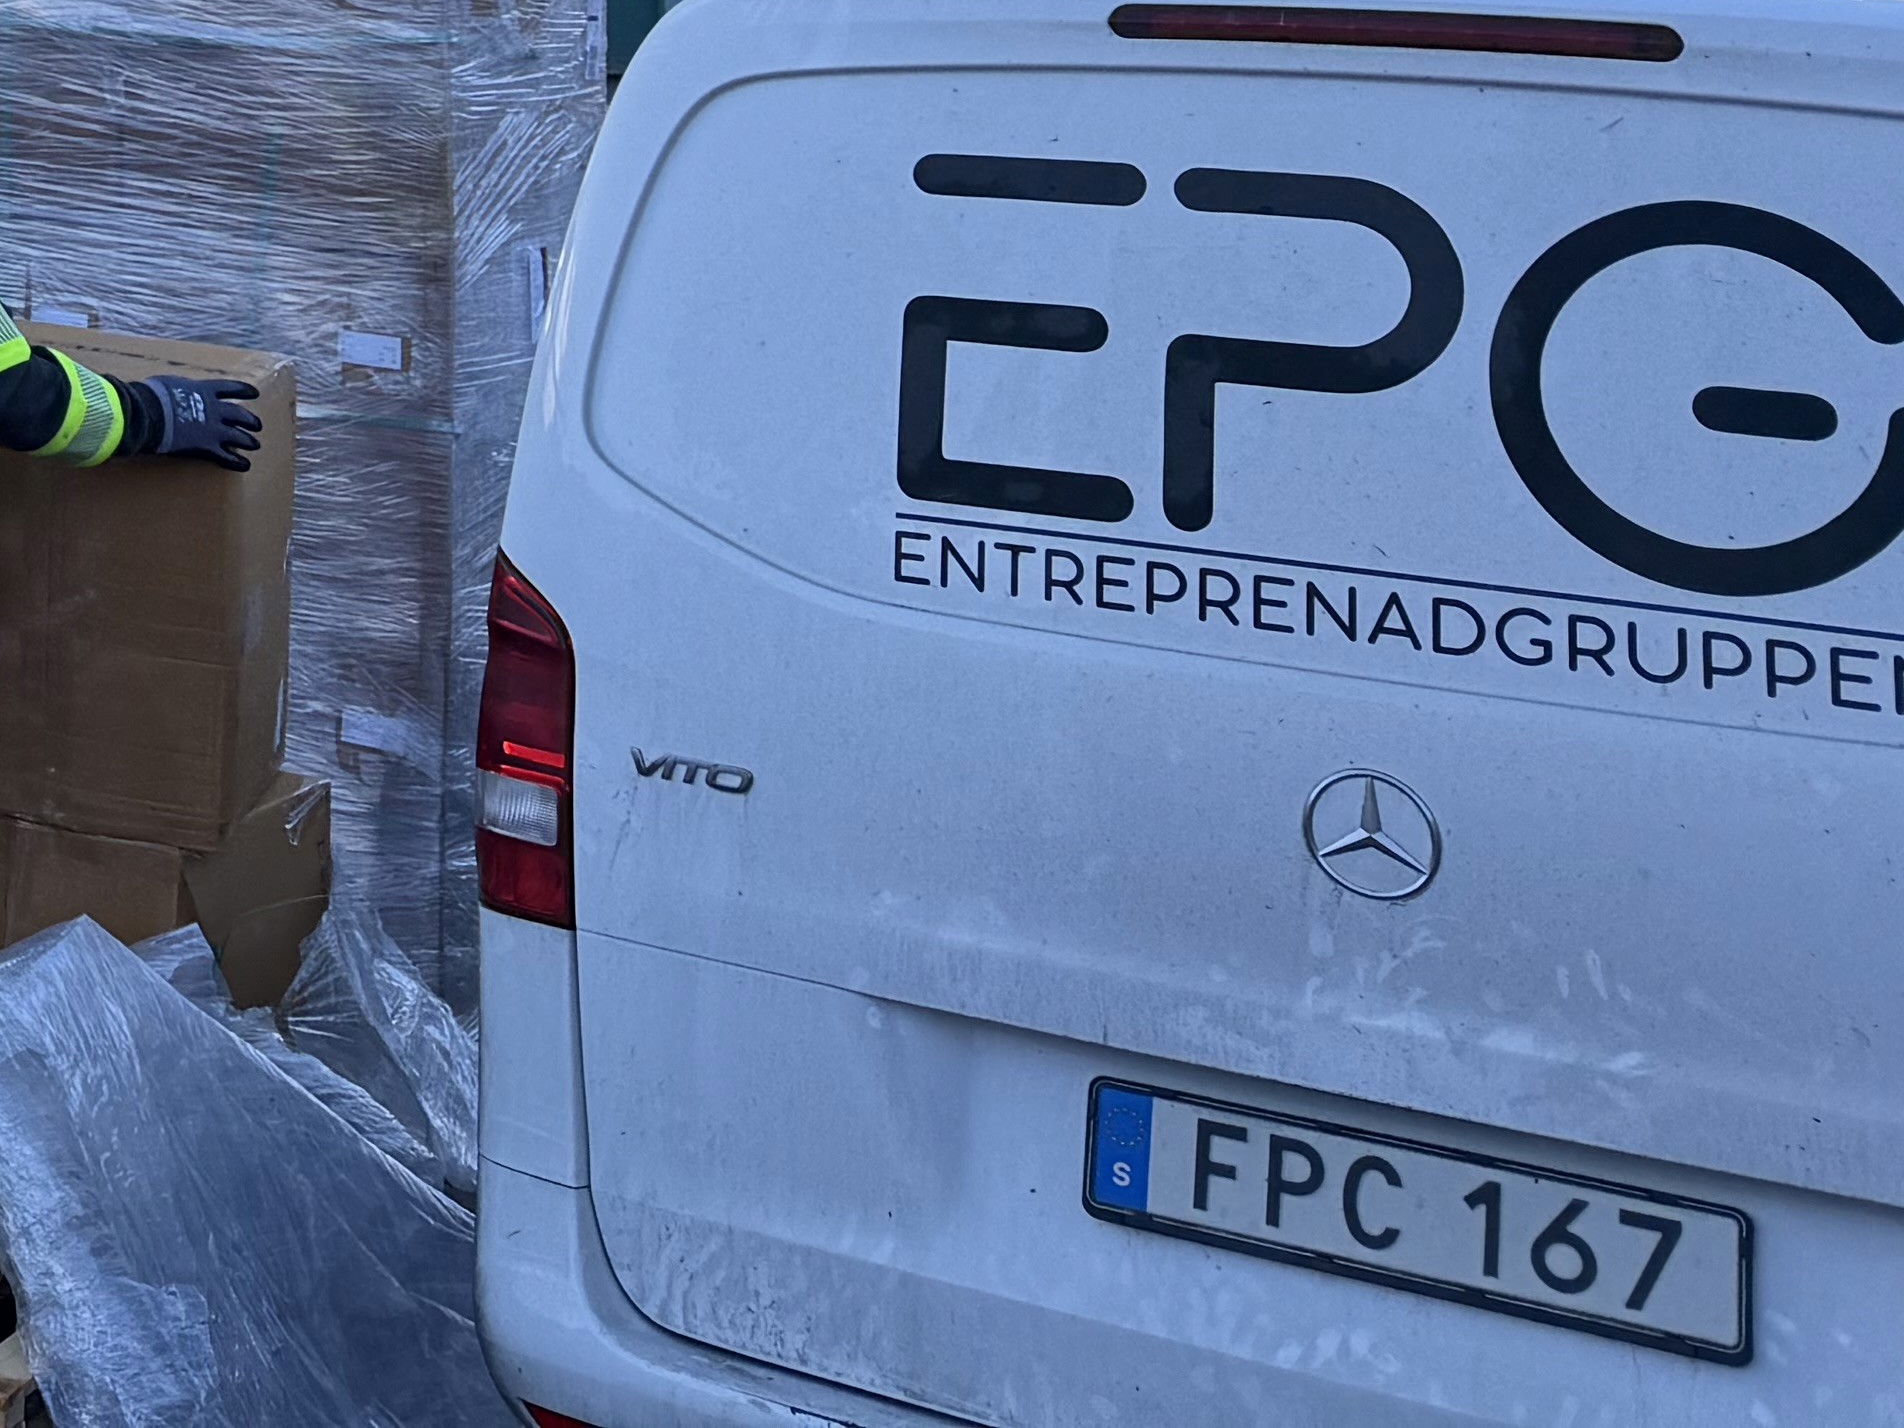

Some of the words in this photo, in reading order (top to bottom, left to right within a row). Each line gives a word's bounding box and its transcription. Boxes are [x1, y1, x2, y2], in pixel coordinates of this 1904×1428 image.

[897, 154, 1904, 597] EPG
[894, 530, 1904, 716] ENTREPRENADGRUPPE
[630, 746, 754, 794] VITO
[1112, 1161, 1131, 1188] S
[1192, 1117, 1404, 1251] FPC
[1463, 1180, 1683, 1312] 167
